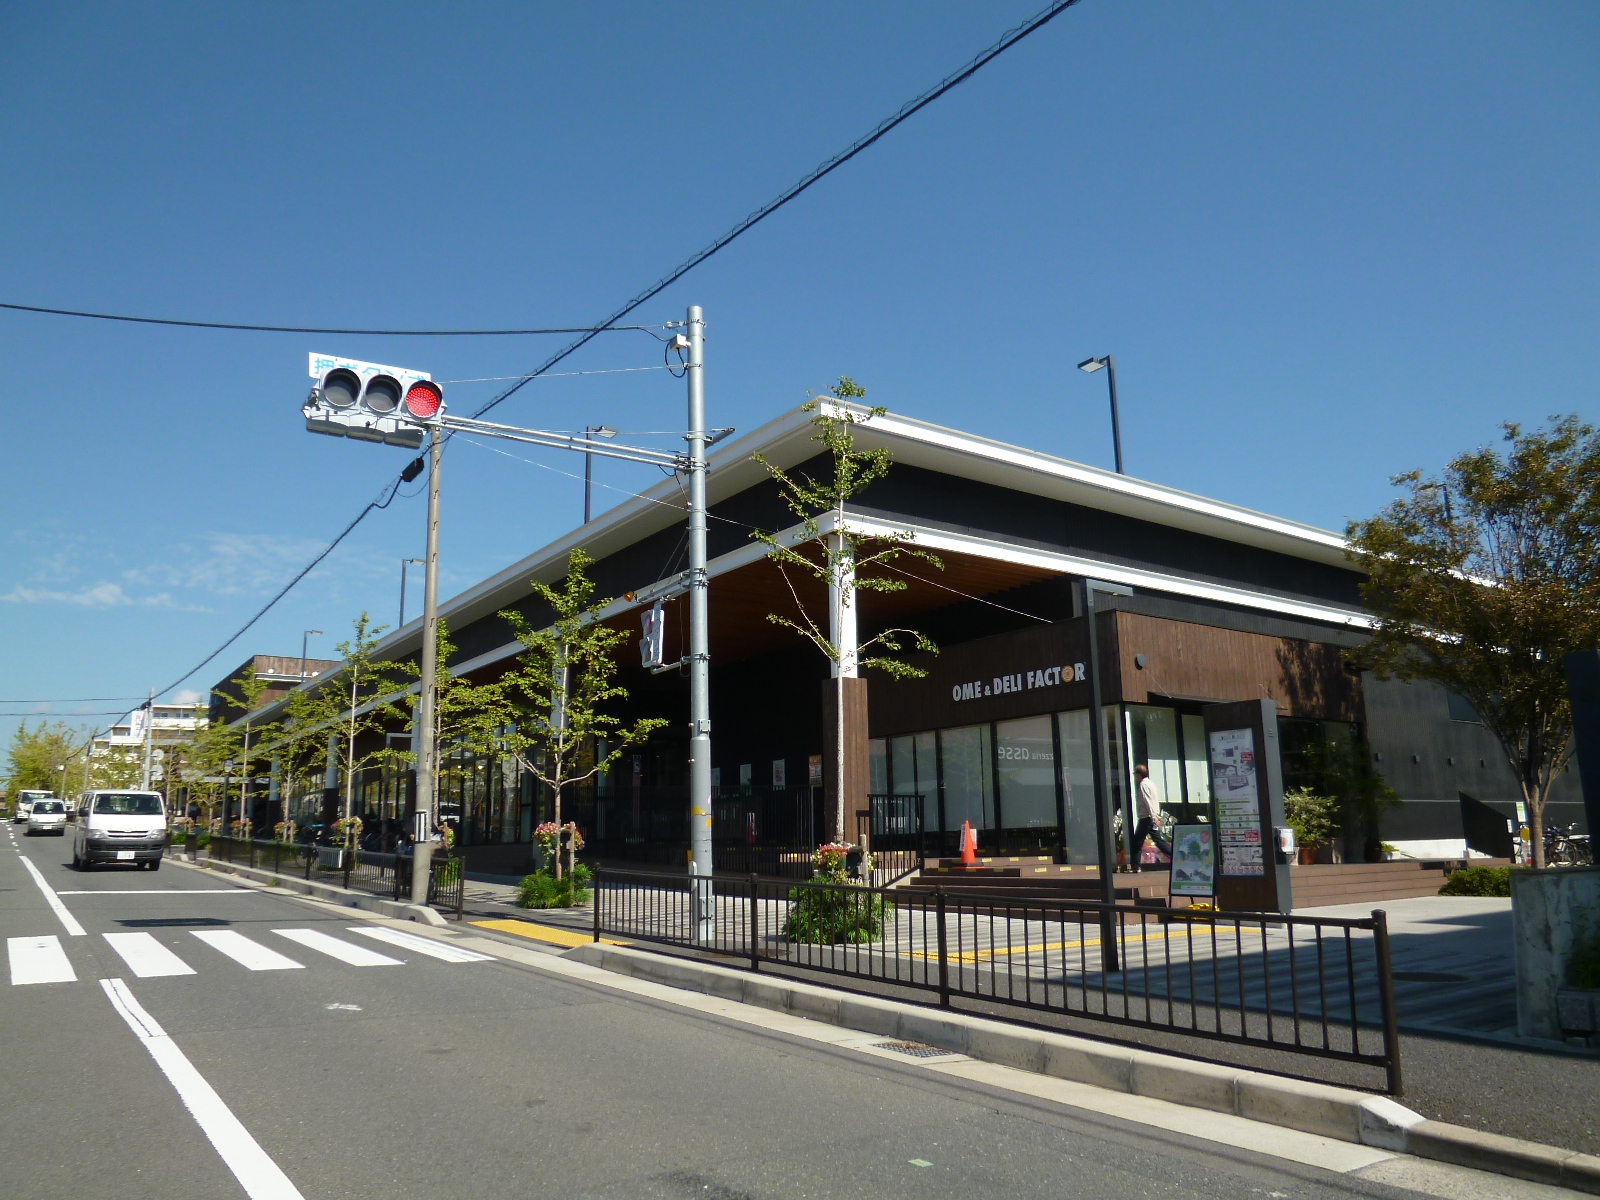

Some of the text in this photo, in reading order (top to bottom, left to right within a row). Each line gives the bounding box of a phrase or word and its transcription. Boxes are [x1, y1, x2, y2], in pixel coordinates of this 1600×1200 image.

[953, 662, 1086, 702] OME & DELI FACTOR
